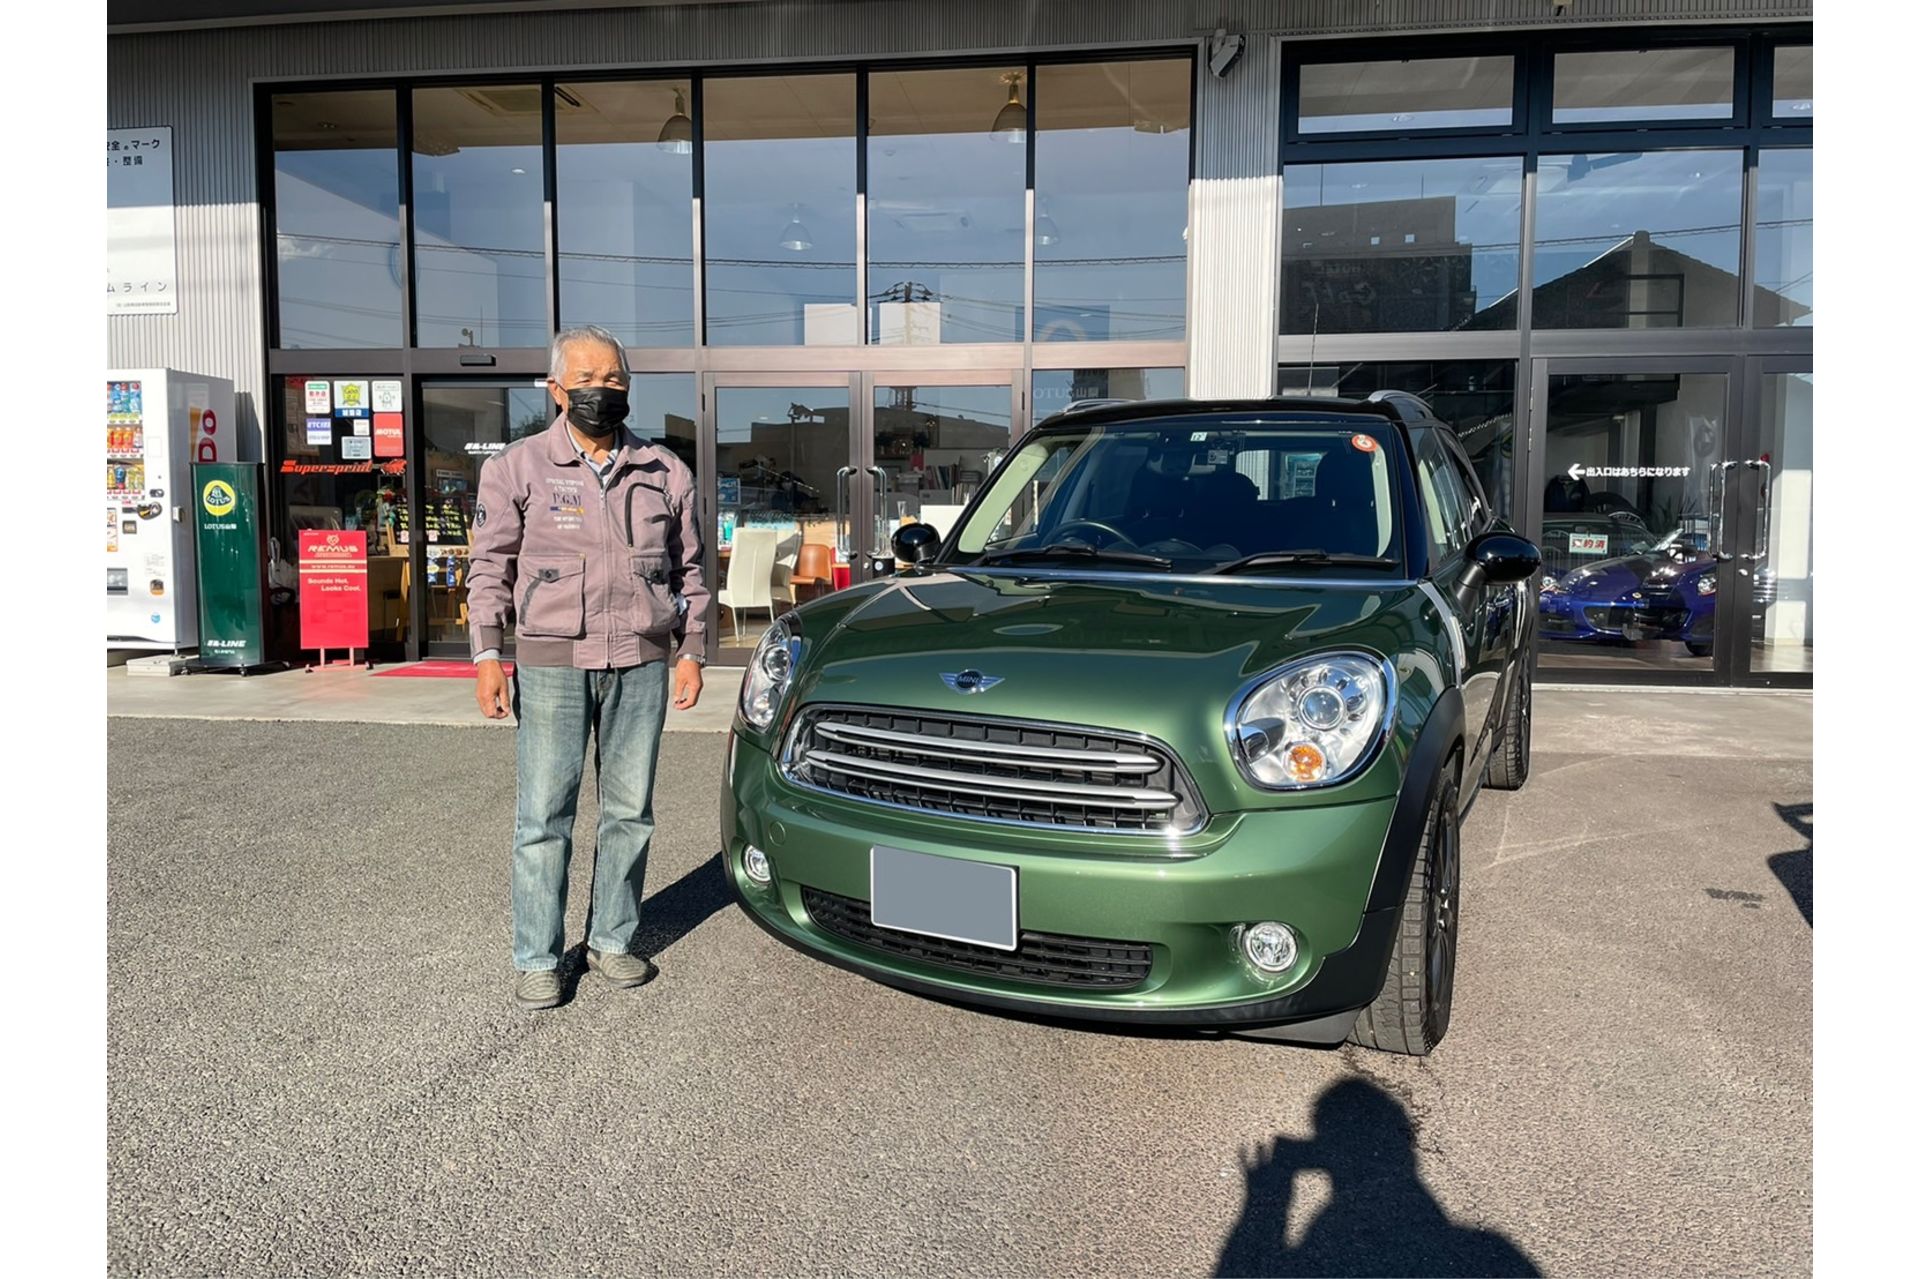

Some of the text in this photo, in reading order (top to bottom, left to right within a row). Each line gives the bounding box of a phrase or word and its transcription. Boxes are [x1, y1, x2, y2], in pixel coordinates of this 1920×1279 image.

[280, 459, 372, 475] Supersprint
[1586, 466, 1690, 478] 出入口はあちらになります
[207, 495, 231, 505] LOTUS
[958, 675, 979, 684] MINI
